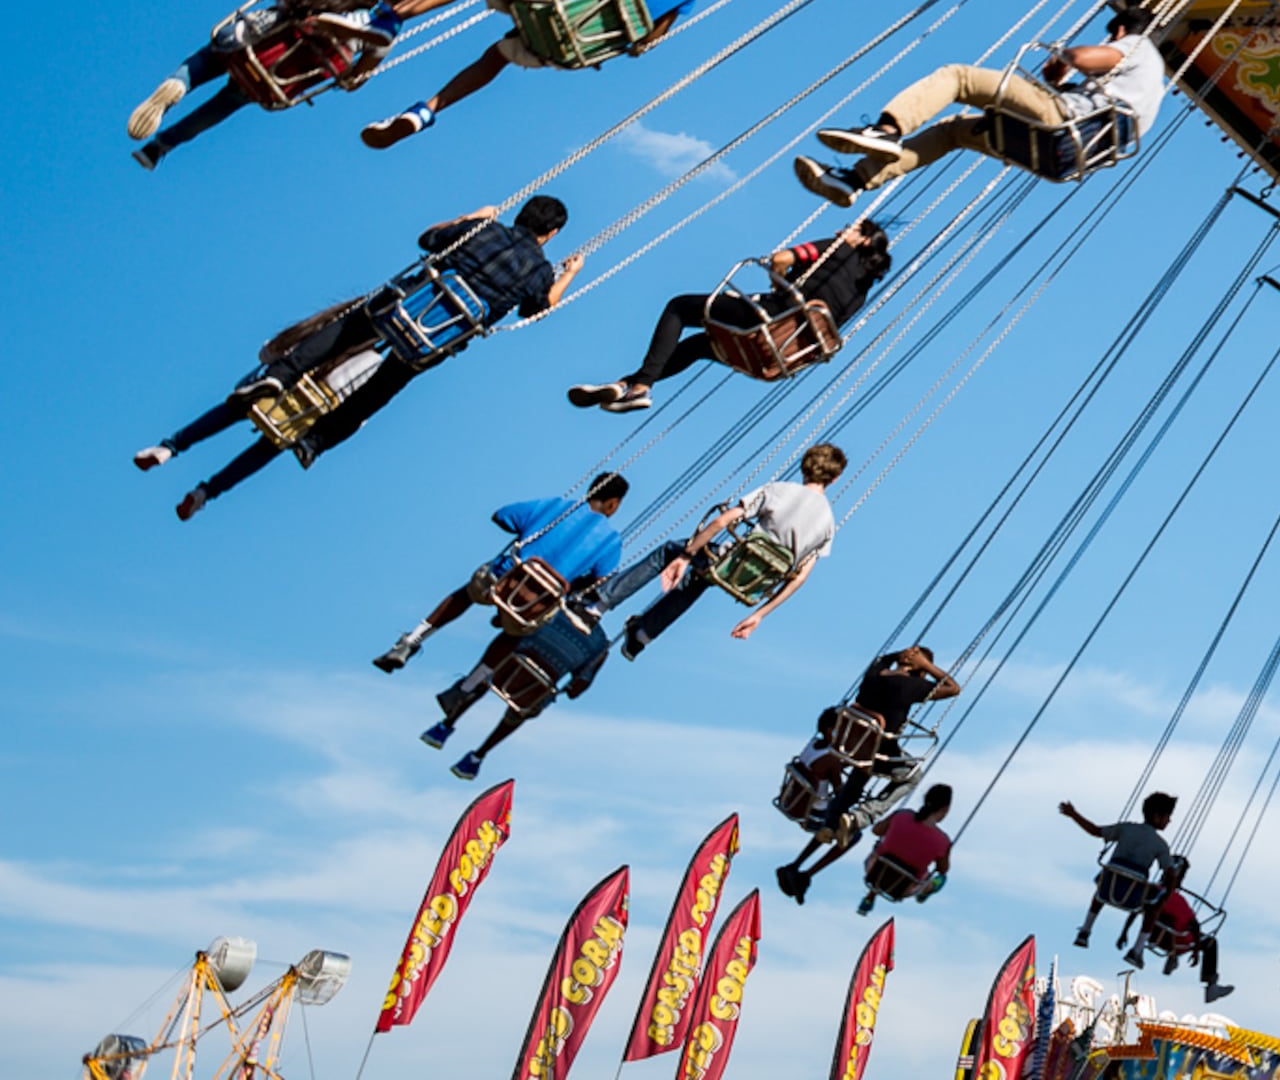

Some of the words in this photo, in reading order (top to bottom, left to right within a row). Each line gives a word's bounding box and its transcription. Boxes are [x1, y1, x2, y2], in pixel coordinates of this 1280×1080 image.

[383, 892, 458, 1019] STED
[449, 819, 502, 897] CORN
[561, 915, 625, 1005] CORN
[648, 927, 702, 1047] ROASTED
[691, 852, 728, 927] CORN
[710, 935, 752, 1021] CORN
[992, 1001, 1030, 1058] COR
